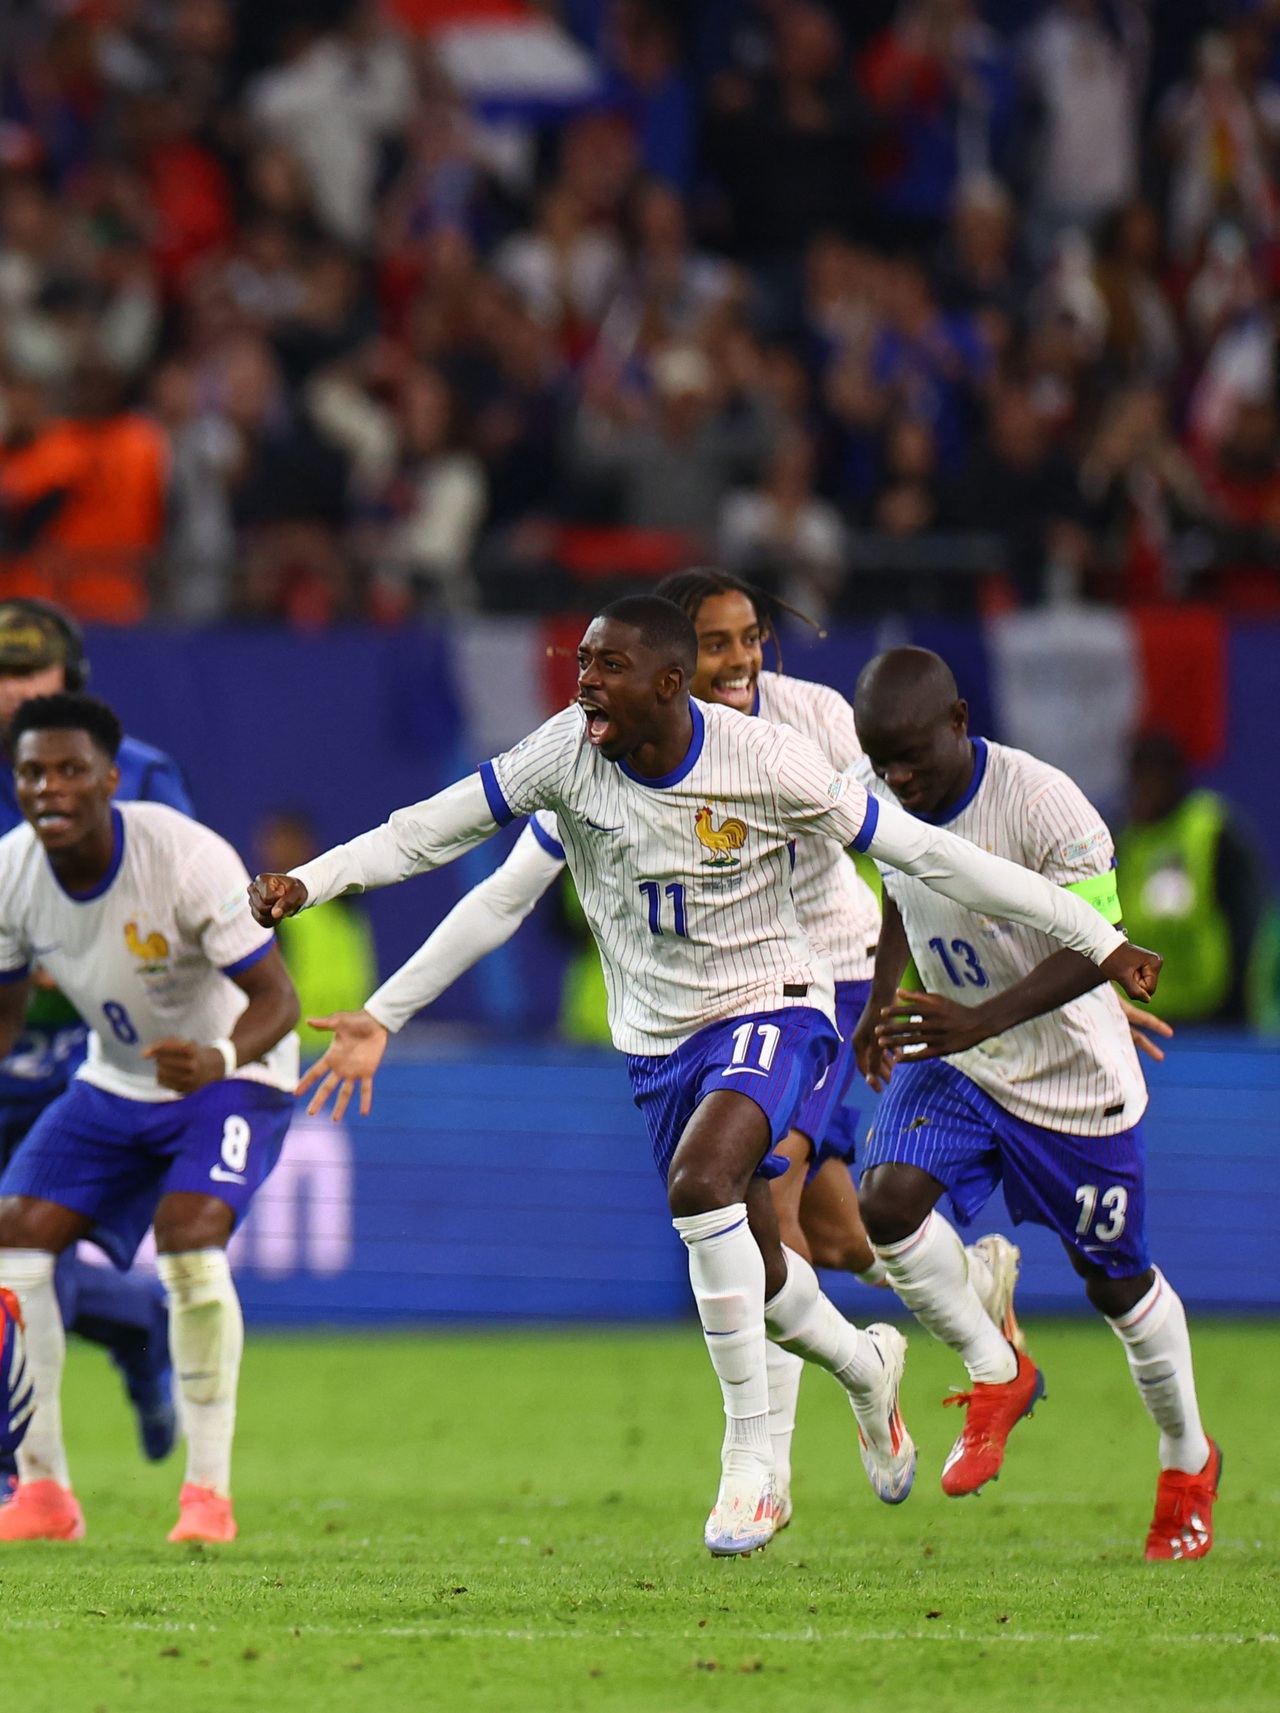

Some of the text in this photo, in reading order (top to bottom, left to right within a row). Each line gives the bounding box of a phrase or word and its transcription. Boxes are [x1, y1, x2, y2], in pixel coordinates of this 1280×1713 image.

[638, 881, 690, 940] 11
[928, 937, 989, 989] 13
[102, 1001, 139, 1046] 8
[731, 1022, 781, 1072] 11
[221, 1114, 251, 1173] 8
[1075, 1184, 1128, 1243] 13
